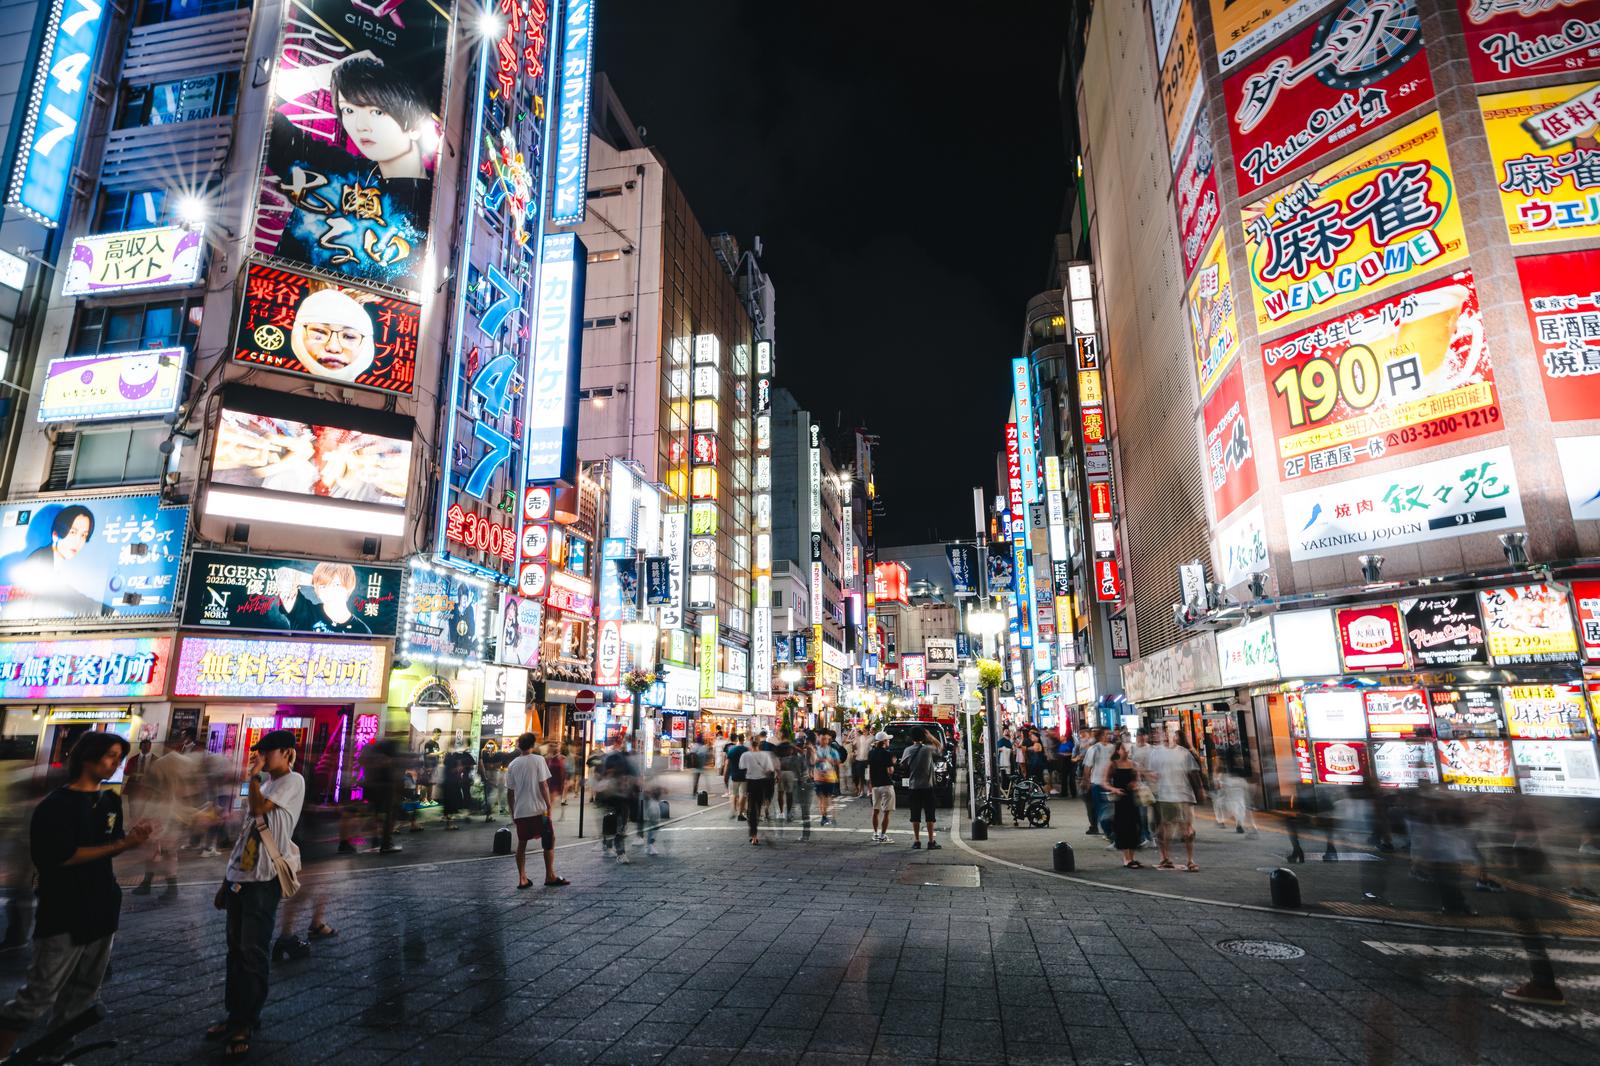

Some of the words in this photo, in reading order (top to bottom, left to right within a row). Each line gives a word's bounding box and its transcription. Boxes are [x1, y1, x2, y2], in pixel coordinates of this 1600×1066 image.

[344, 13, 397, 41] alpha
[1231, 9, 1272, 40] 生ビール
[557, 57, 585, 211] カラオケランド
[1262, 163, 1439, 280] 麻雀
[105, 235, 165, 260] 高収入
[100, 257, 162, 282] バイト
[1264, 231, 1434, 318] WELCOME
[372, 307, 398, 376] オープン
[537, 276, 568, 392] カラオケ
[1265, 294, 1419, 364] いつでも生ビールが
[249, 352, 284, 365] CERN
[392, 312, 418, 383] 新店舗
[1084, 337, 1095, 362] ダーツ
[465, 264, 522, 499] 747
[1084, 414, 1103, 439] 麻雀
[1285, 457, 1306, 477] 2F
[1309, 438, 1385, 471] 居酒屋一休
[1401, 405, 1500, 445] 03-3200-1219
[1334, 499, 1374, 519] 焼肉
[1455, 511, 1477, 525] 9F
[102, 518, 174, 546] モテるって
[446, 504, 518, 563] 全300室
[669, 516, 678, 561] しゃぶしゃぶ
[1300, 532, 1368, 551] YAKINIKU
[1372, 521, 1423, 542] JOJOEN
[206, 576, 247, 587] 2022.06.25
[203, 610, 229, 619] NORN
[1418, 598, 1458, 611] ダイニング
[1432, 612, 1476, 625] ダーツバー
[1486, 593, 1509, 629] 九十九
[454, 647, 468, 655] ACQUA
[19, 651, 157, 687] 無料案内所
[196, 650, 370, 687] 無料案内所
[1512, 687, 1555, 699] 低料金
[1514, 702, 1580, 724] 麻雀
